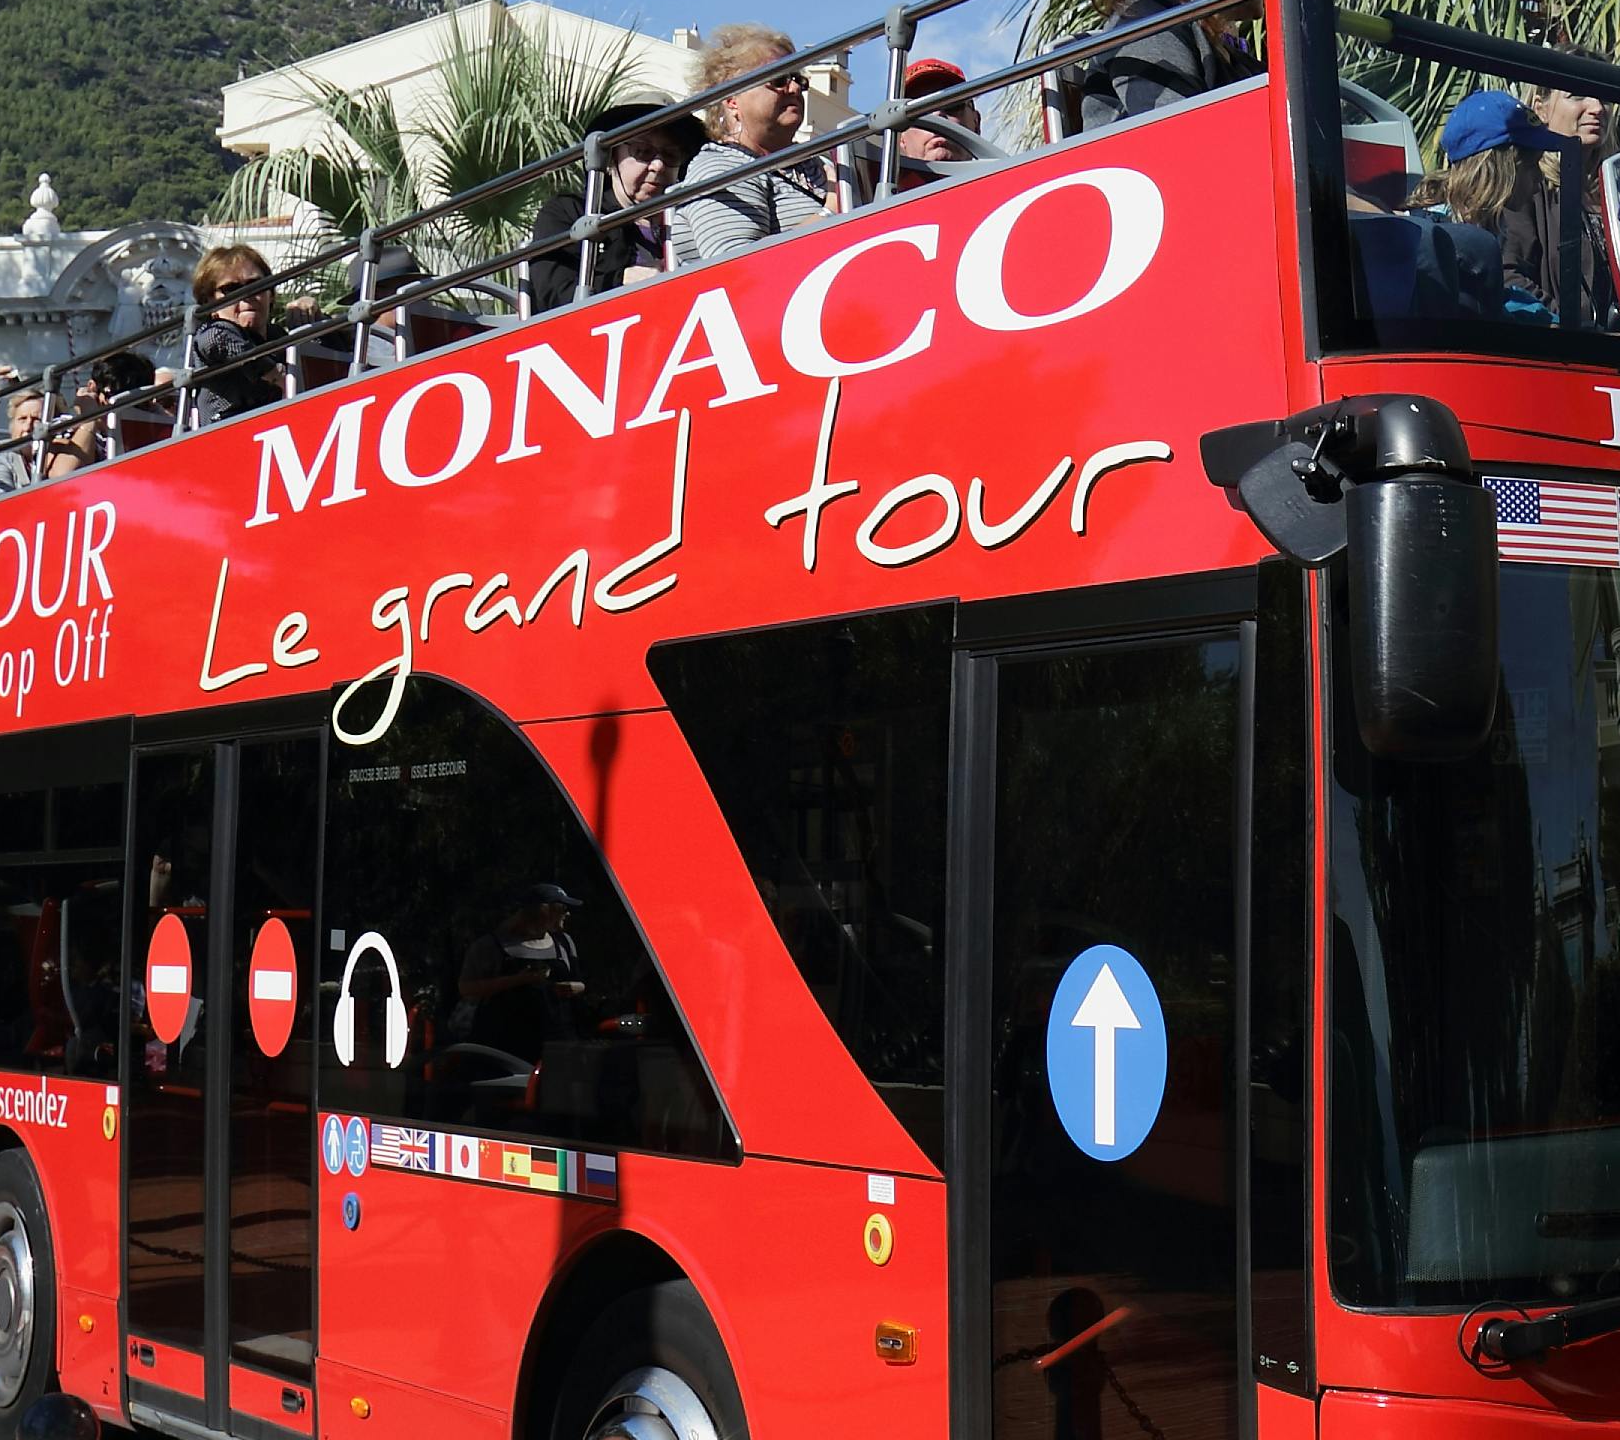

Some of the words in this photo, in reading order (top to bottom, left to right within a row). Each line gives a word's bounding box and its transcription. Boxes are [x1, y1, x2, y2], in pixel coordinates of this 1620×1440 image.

[244, 166, 1165, 529] MONACO
[54, 604, 113, 687] Off
[199, 557, 320, 692] Le
[332, 407, 691, 746] grand
[764, 377, 1173, 572] tour
[429, 763, 437, 778] DE
[438, 760, 467, 776] SECOURS
